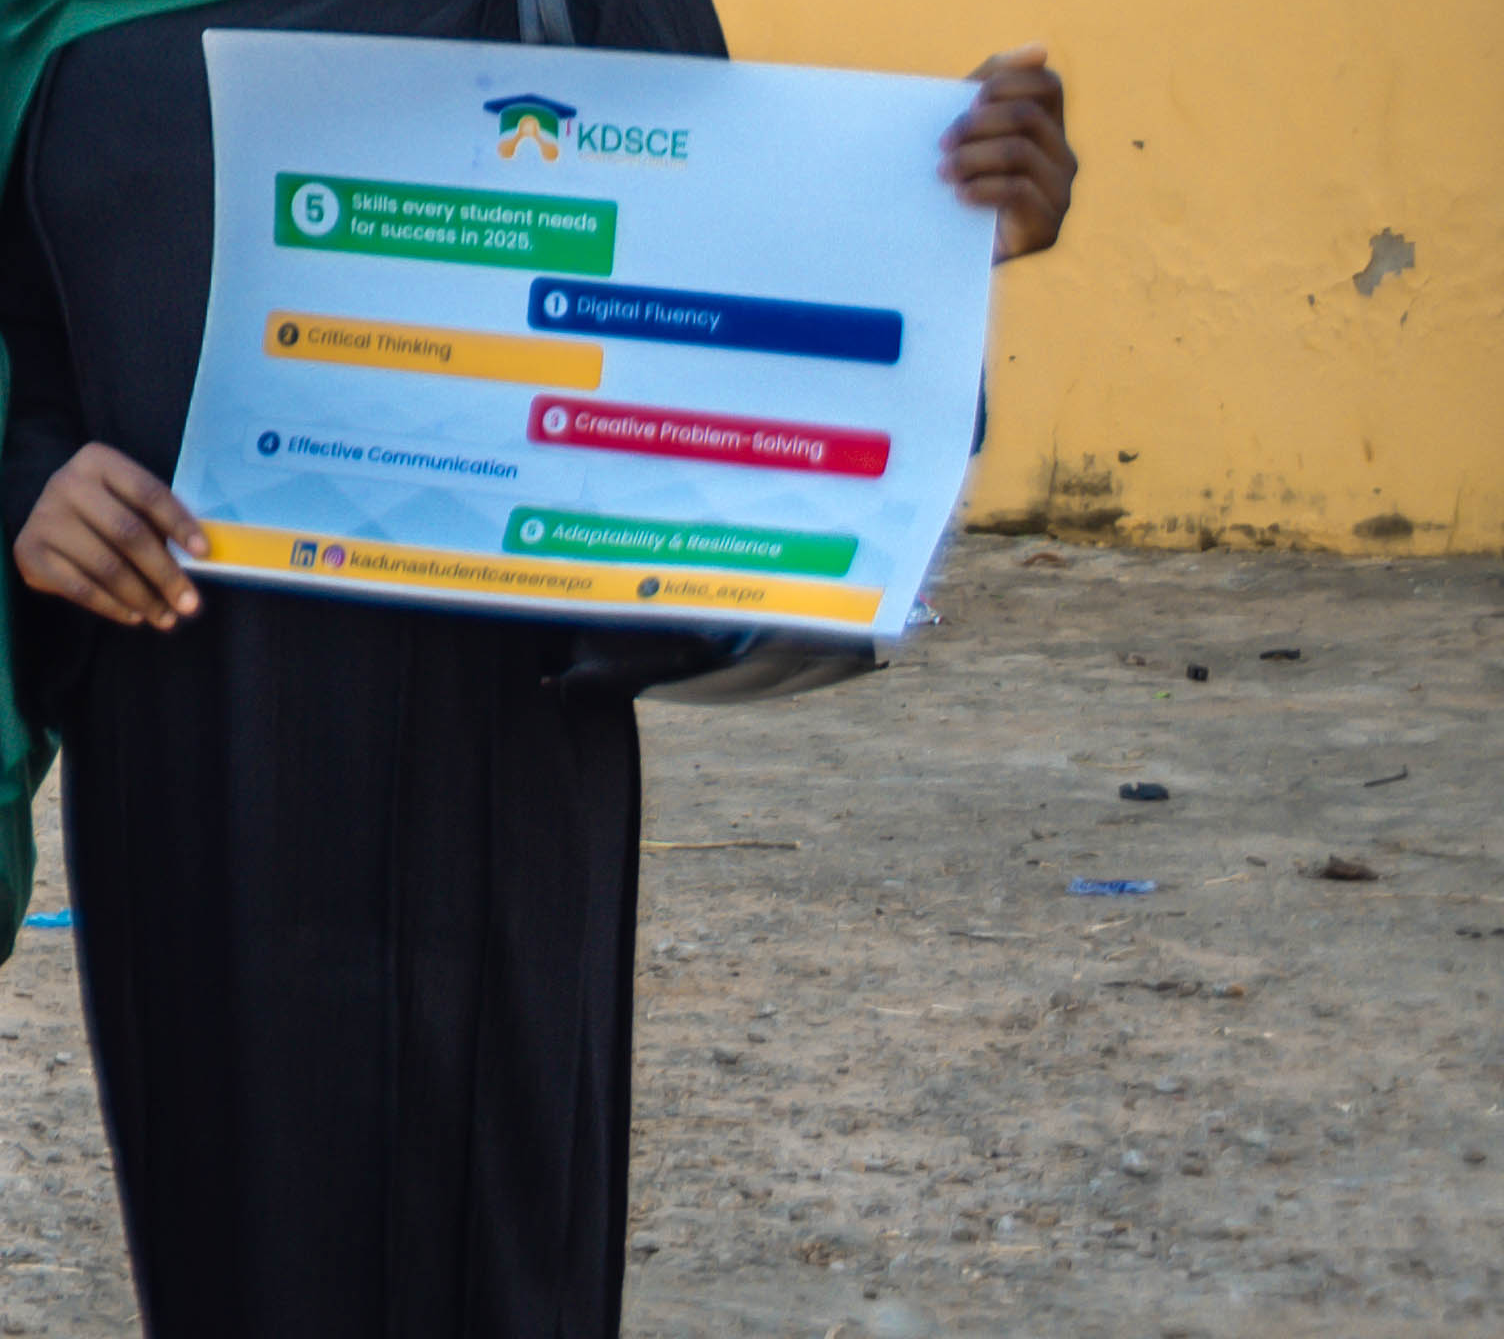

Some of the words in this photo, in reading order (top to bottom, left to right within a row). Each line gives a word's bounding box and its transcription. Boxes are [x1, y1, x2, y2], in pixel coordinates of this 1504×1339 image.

[577, 122, 689, 159] KDSCE
[306, 194, 324, 223] 5
[352, 193, 398, 214] Skills
[402, 201, 454, 222] every
[460, 204, 533, 226] student
[538, 212, 597, 232] needs
[351, 217, 375, 235] for
[381, 224, 456, 244] success
[461, 227, 479, 246] in
[577, 295, 638, 321] Digital
[644, 302, 720, 332] Fluency
[308, 327, 371, 349] Critical
[376, 334, 453, 362] Thinking
[575, 412, 656, 439] Creative
[660, 421, 824, 464] Problem-Solving
[288, 435, 363, 461] Effective
[367, 446, 518, 480] Communication
[552, 523, 665, 553] Adaptability
[668, 533, 683, 551] &
